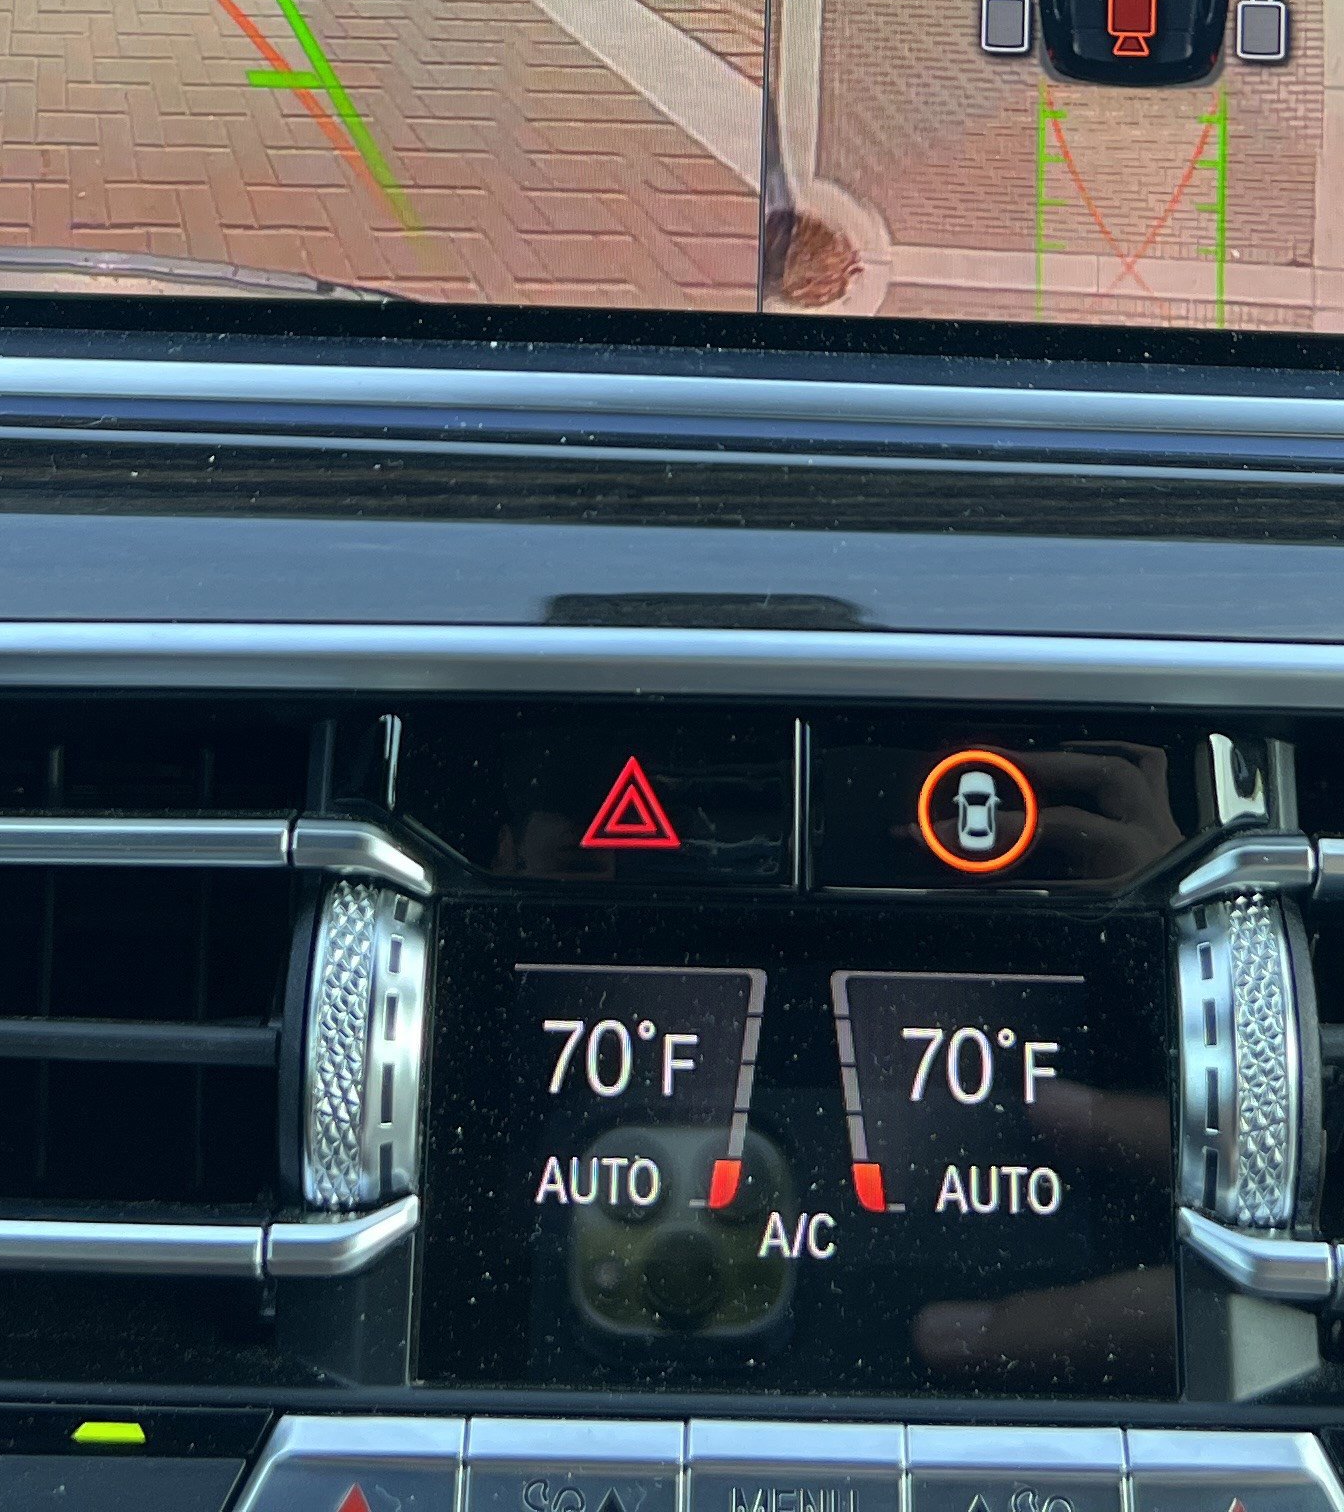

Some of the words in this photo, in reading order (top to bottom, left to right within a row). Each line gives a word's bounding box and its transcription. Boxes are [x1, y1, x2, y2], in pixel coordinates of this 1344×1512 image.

[542, 1019, 699, 1097] 70°F
[902, 1027, 1058, 1104] 70°F
[535, 1157, 661, 1206] AUTO
[935, 1165, 1061, 1213] AUTO
[758, 1213, 838, 1259] A/C
